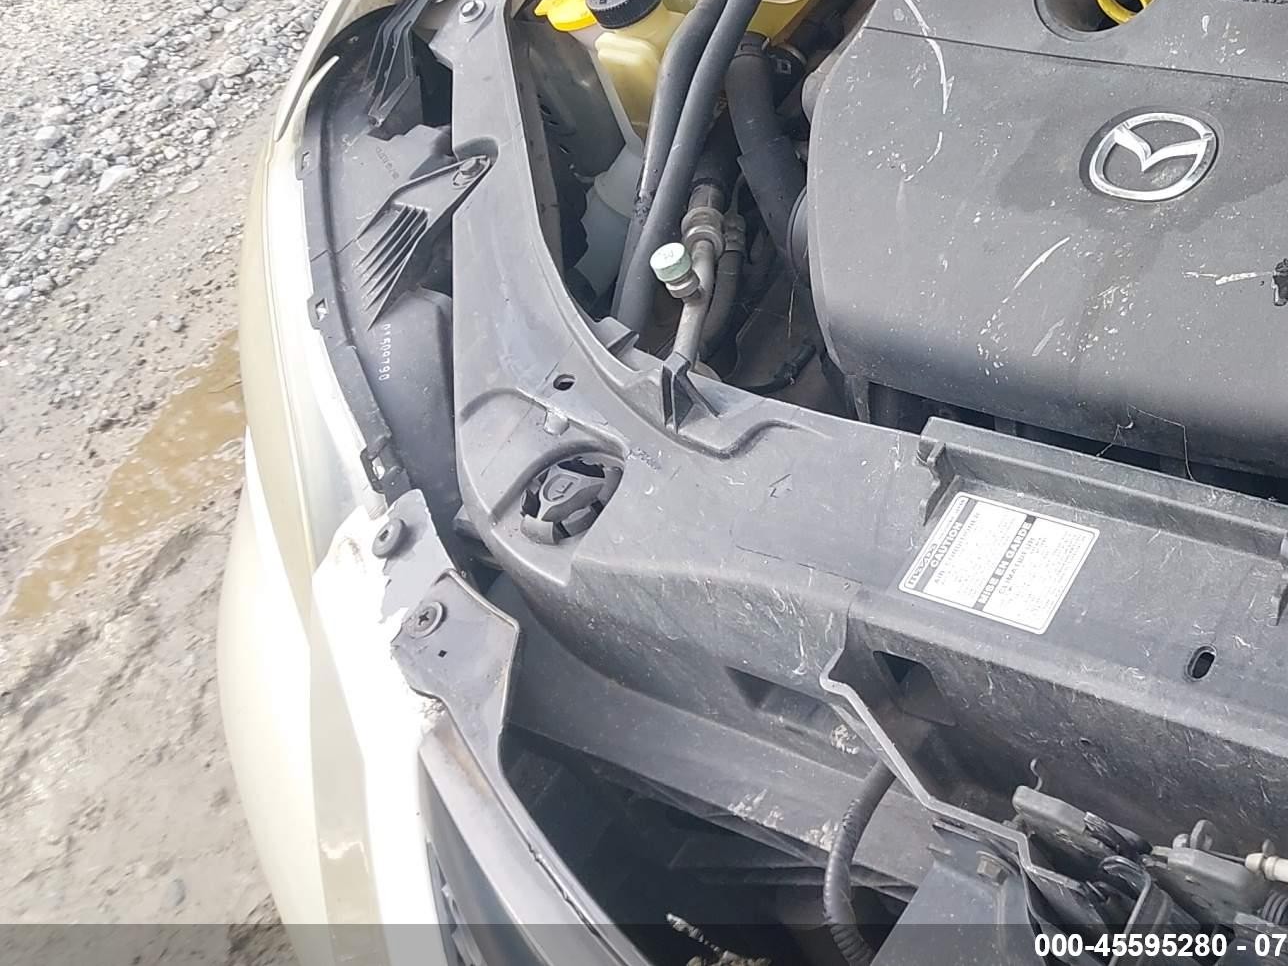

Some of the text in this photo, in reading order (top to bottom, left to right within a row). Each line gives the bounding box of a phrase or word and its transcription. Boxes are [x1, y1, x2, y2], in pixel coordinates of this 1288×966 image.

[930, 521, 963, 569] CAUTION
[978, 521, 1032, 605] MISE EN GARDE
